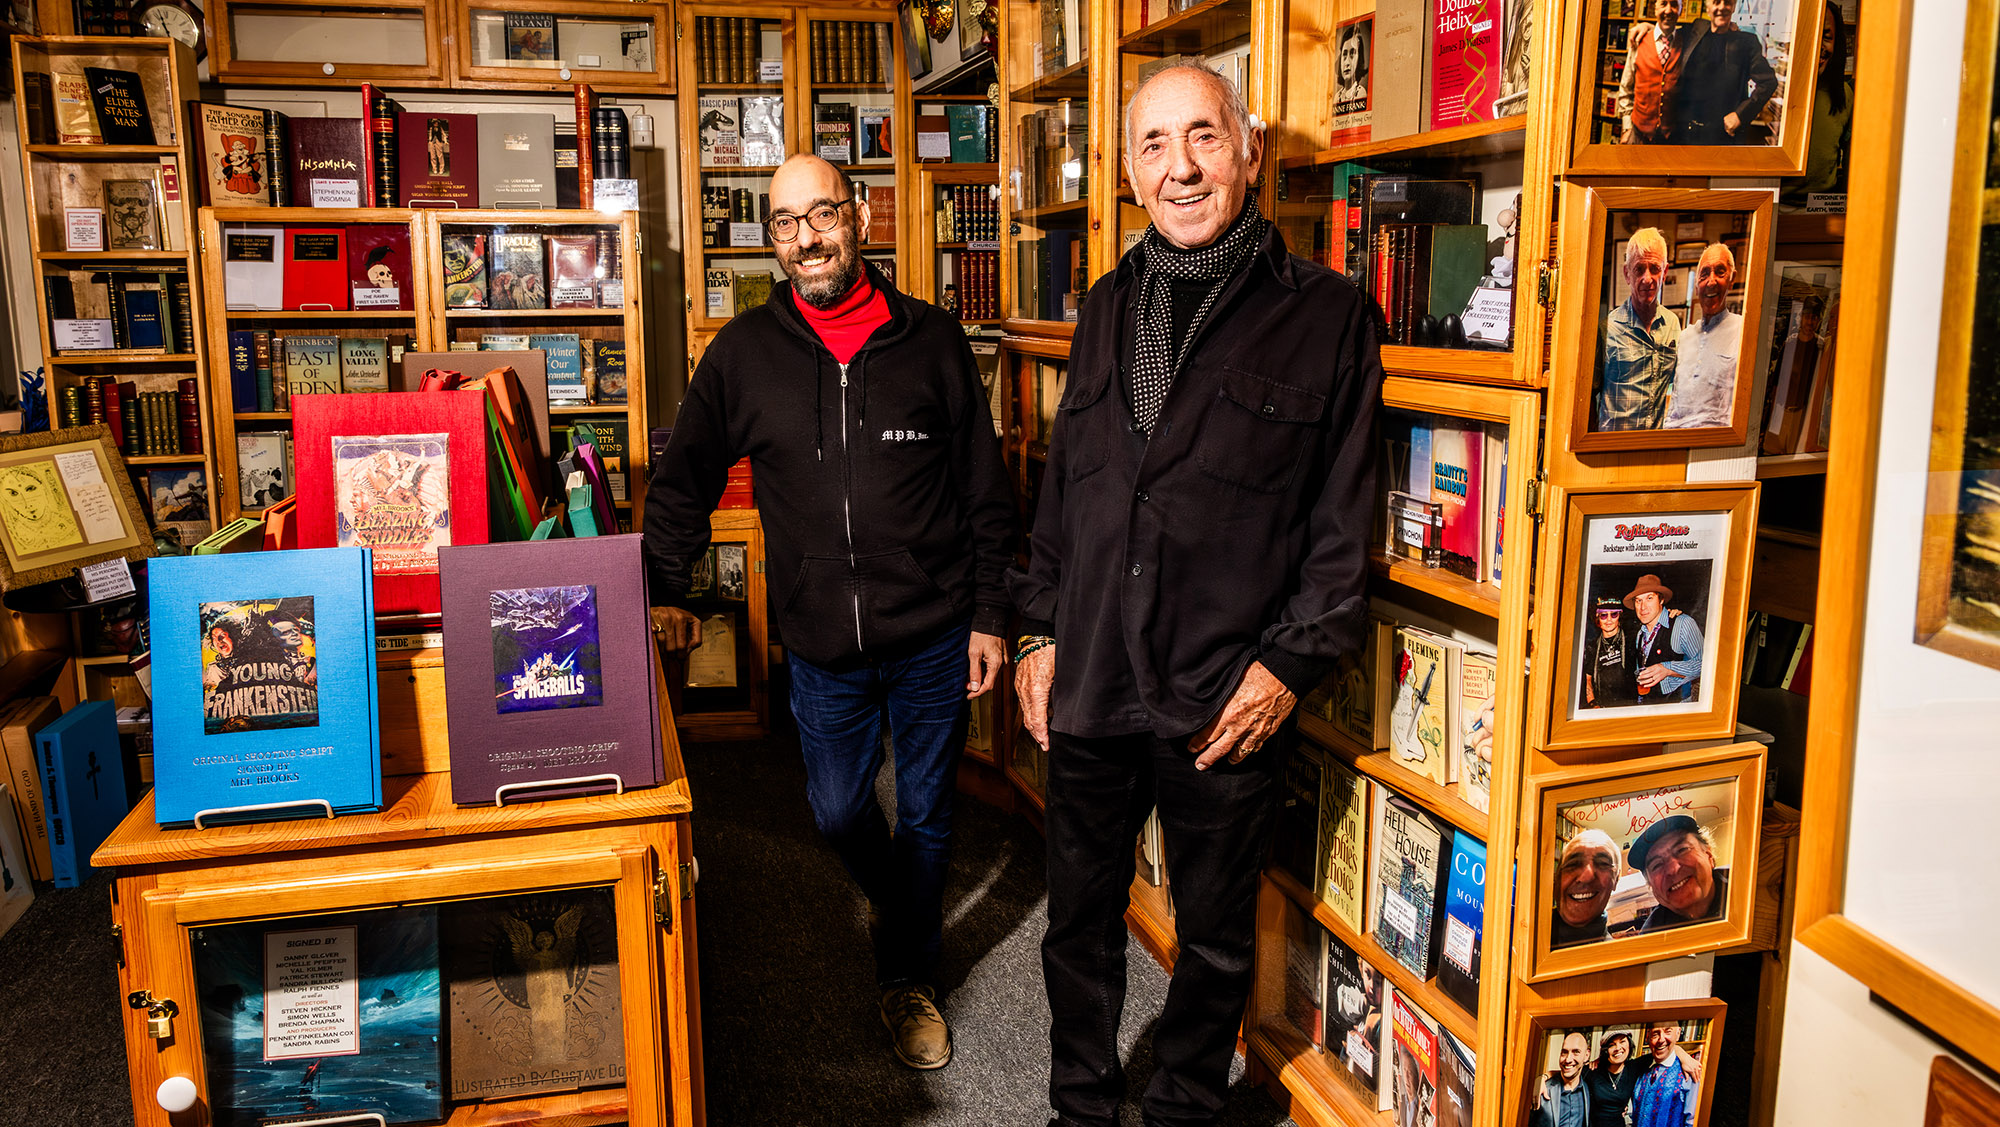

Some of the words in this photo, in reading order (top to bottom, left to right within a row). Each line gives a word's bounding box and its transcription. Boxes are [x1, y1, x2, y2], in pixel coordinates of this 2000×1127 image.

[509, 20, 551, 28] ISLAND
[1437, 12, 1473, 34] Helix
[1438, 42, 1458, 57] James
[1467, 35, 1491, 50] Watson
[59, 81, 87, 89] SLABS
[111, 88, 129, 98] THE
[105, 97, 137, 108] ELDER
[722, 99, 738, 110] PARK
[206, 114, 239, 127] FATHER
[226, 111, 250, 119] SONGS
[114, 116, 138, 127] MAN
[815, 123, 851, 133] SCHINDLER'S
[714, 146, 740, 155] MICHAEL
[300, 159, 356, 171] INSOMNIA
[713, 156, 740, 165] CRICHTON
[495, 234, 538, 253] DRACULA
[286, 338, 335, 347] STEINBECK
[531, 334, 576, 343] STEINBECK
[287, 350, 336, 366] EAST
[350, 350, 376, 358] LONG
[549, 347, 577, 358] Winter
[345, 358, 380, 366] VALLEY
[550, 359, 569, 369] Our
[607, 357, 624, 367] Row
[303, 368, 320, 379] OF
[290, 381, 338, 395] EDEN
[596, 427, 614, 435] ONE
[1434, 461, 1468, 483] GRAVITY'S
[1434, 475, 1468, 498] RAINBOW
[387, 504, 414, 512] BROOKS
[356, 511, 432, 529] BLAZING
[1397, 526, 1423, 541] PYNCHON
[1614, 523, 1658, 541] Rolling
[1656, 522, 1691, 538] Stone
[354, 529, 436, 547] SADDLES
[1603, 544, 1625, 553] Backstage
[1625, 543, 1635, 552] with
[1635, 543, 1652, 552] Johnny
[1651, 542, 1664, 551] Depp
[1663, 542, 1672, 550] and
[1672, 541, 1684, 550] Todd
[388, 637, 409, 648] TIDE
[1407, 638, 1440, 662] FLEMING
[231, 662, 293, 685] YOUNG
[513, 674, 585, 700] SPACEBALLS
[203, 685, 318, 719] FRANKENSTEIN
[193, 754, 242, 766] ORIGINAL
[244, 749, 296, 762] SHOOTING
[299, 746, 334, 757] SCRIPT
[487, 750, 533, 762] ORIGINAL
[536, 746, 585, 758] SHOOTING
[587, 742, 619, 754] SCRIPT
[568, 753, 608, 766] BROOKS
[237, 764, 274, 775] SIGNED
[277, 762, 290, 771] BY
[21, 769, 32, 788] GOD
[230, 777, 252, 787] MEL
[256, 772, 300, 785] BROOKS
[27, 788, 35, 799] OF
[30, 801, 41, 824] HAND
[1384, 807, 1409, 836] HELL
[36, 824, 46, 839] THE
[1394, 832, 1432, 869] HOUSE
[1327, 886, 1356, 924] NOVEL
[286, 939, 321, 948] SIGNED
[324, 937, 337, 945] BY
[1330, 941, 1344, 958] THE
[275, 960, 311, 968] MICHELLE
[313, 958, 347, 966] PFEIFFER
[283, 954, 309, 962] DANNY
[310, 952, 340, 960] GLOVER
[306, 965, 333, 973] KILMER
[1328, 953, 1362, 989] CHILDREN
[279, 973, 310, 982] PATRICK
[310, 971, 344, 979] STEWART
[279, 980, 309, 988] SANDRA
[310, 977, 344, 986] BULLOCK
[283, 986, 308, 994] RALPH
[309, 984, 340, 992] FIENNES
[295, 999, 328, 1007] DIRECTORS
[1341, 991, 1356, 1007] MEN
[281, 1007, 308, 1015] STEVEN
[310, 1004, 342, 1013] HICKNER
[287, 1013, 310, 1021] SIMON
[311, 1011, 336, 1019] WELLS
[278, 1020, 308, 1029] BRENDA
[309, 1017, 345, 1026] CHAPMAN
[300, 1025, 336, 1033] PRODUCERS
[269, 1034, 298, 1043] PENNEY
[298, 1031, 339, 1040] FINKELMAN
[283, 1040, 312, 1048] SANDRA
[314, 1038, 340, 1046] RABINS
[530, 1071, 548, 1086] BY
[550, 1067, 605, 1085] GUSTAVE
[1343, 1069, 1374, 1106] JAMES
